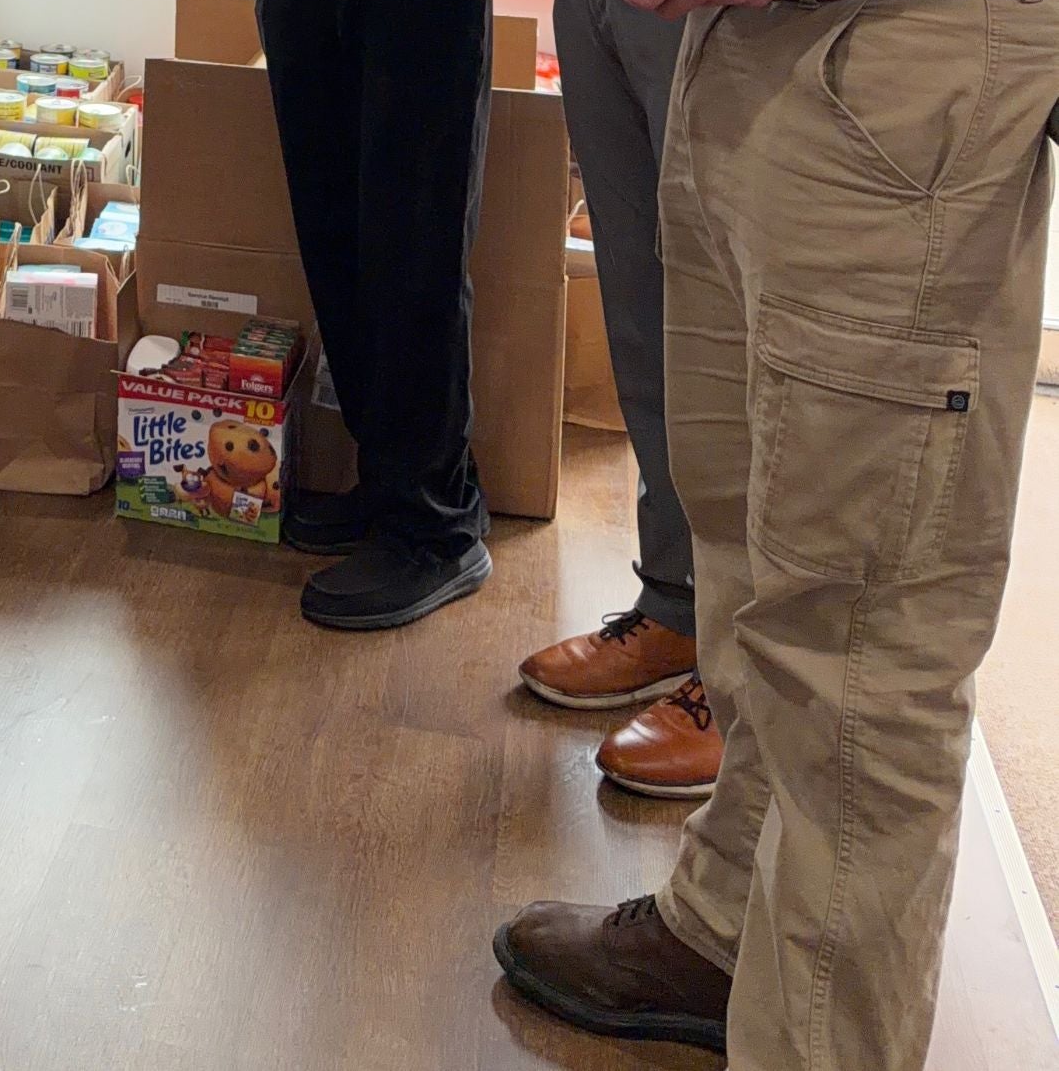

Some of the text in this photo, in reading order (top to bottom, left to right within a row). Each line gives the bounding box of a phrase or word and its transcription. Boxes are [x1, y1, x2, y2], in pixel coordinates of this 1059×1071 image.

[241, 378, 274, 394] Folgers
[121, 380, 275, 421] VALUE PACK 10
[133, 411, 187, 446] Little
[149, 439, 206, 466] Bites
[117, 499, 130, 510] 10
